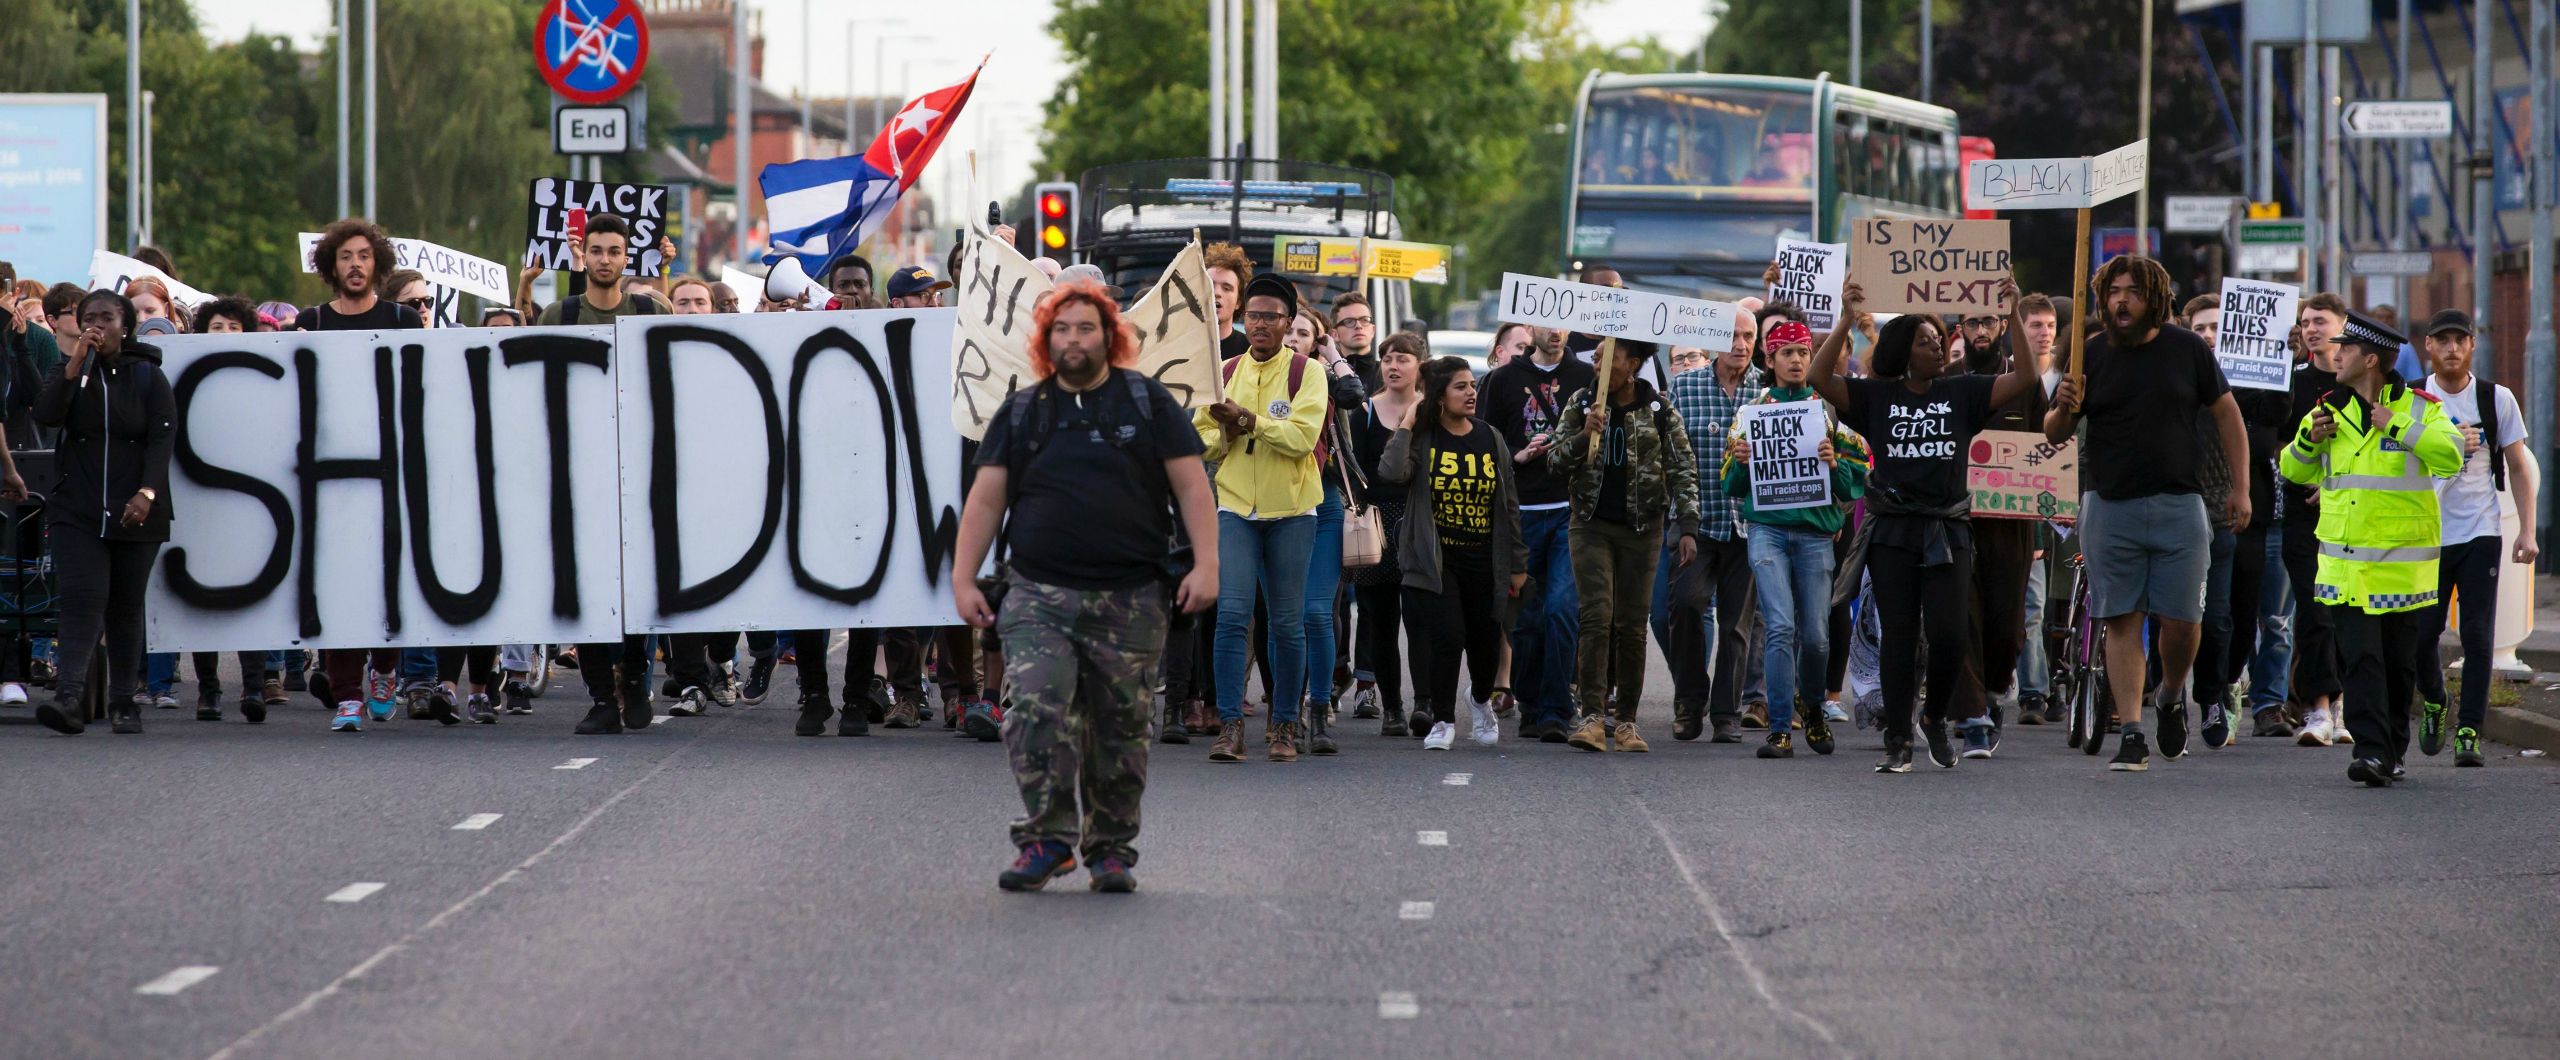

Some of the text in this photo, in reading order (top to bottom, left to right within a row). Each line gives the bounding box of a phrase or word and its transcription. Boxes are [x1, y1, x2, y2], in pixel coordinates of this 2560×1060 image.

[571, 119, 616, 139] End
[1983, 162, 2072, 198] BLACK
[535, 177, 665, 219] BLACK
[1866, 220, 1954, 248] IS MY
[526, 238, 663, 278] MAER
[1787, 245, 1833, 256] Socialist Worker
[1889, 248, 2010, 274] BROTHER
[1287, 261, 1317, 271] DEALS
[1779, 251, 1825, 274] BLACK
[1777, 270, 1816, 292] IVES
[2236, 285, 2286, 297] Socialist Worker
[1591, 290, 1629, 304] DEATHS
[1773, 288, 1832, 311] MATTER
[2224, 291, 2278, 317] BLACK
[1580, 310, 1628, 322] IN POLICE
[1679, 304, 1718, 319] POLICE
[1593, 323, 1629, 333] CUSTODY
[2222, 312, 2268, 337] LIVES
[2220, 333, 2286, 360] MATTER
[2236, 360, 2261, 373] racist
[2263, 365, 2283, 377] cops
[1758, 407, 1809, 418] Socialist Worker
[1888, 400, 1953, 419] BLACK
[1750, 415, 1804, 441] BLACK
[1891, 418, 1953, 440] GIRL
[1751, 437, 1799, 461] LIVES
[1886, 440, 1957, 458] MAGIC
[646, 317, 974, 617] DOW
[1753, 456, 1820, 481] MATTER
[164, 334, 610, 641] SHUT
[1429, 476, 1497, 494] EATHS
[1758, 483, 1823, 497] Jail racist cops
[1969, 467, 2058, 492] POLICE
[1442, 492, 1490, 504] POLIC
